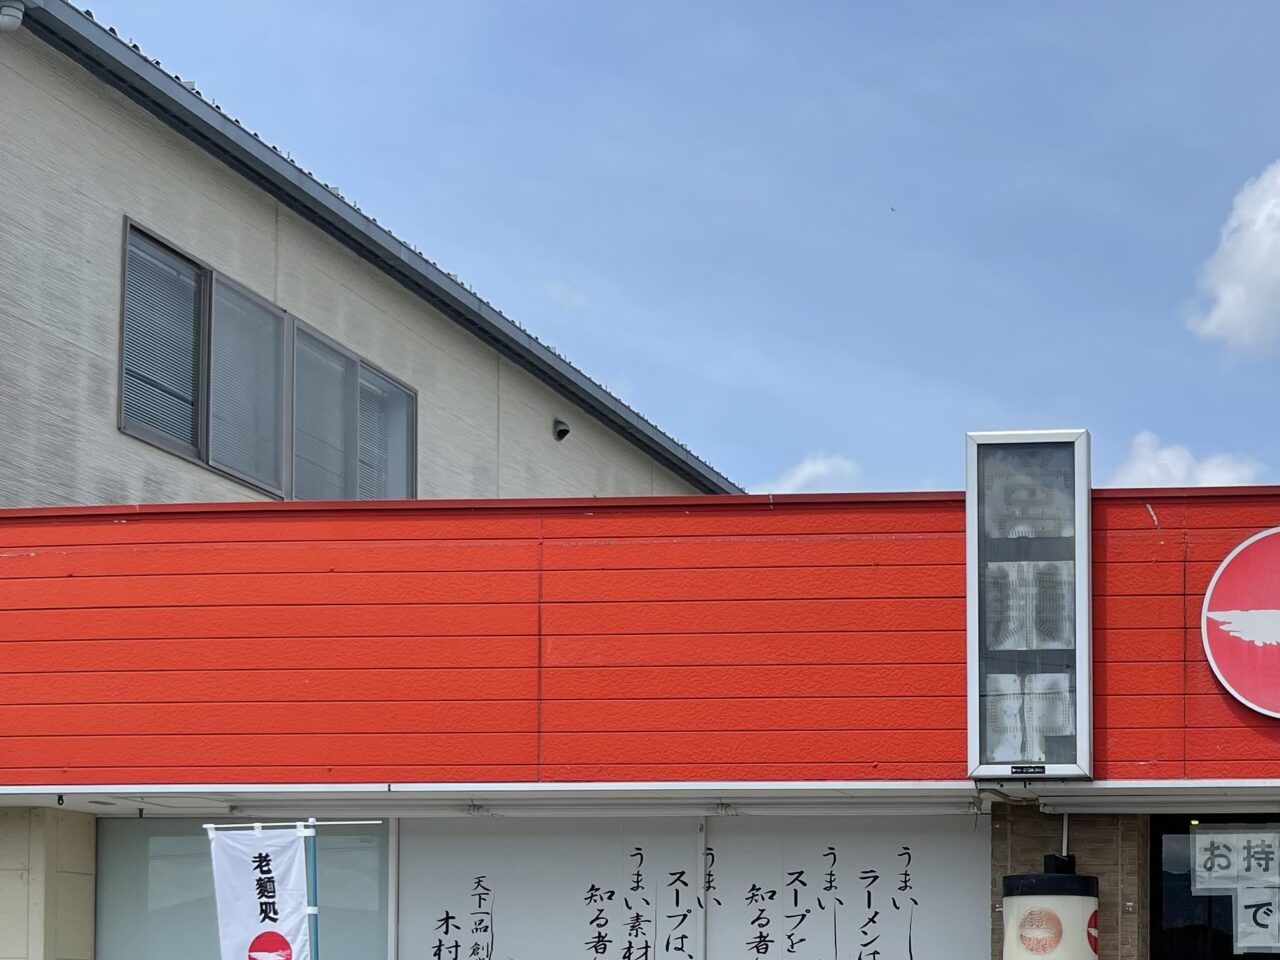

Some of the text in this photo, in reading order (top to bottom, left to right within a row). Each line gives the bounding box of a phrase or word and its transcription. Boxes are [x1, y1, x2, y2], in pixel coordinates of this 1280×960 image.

[470, 875, 491, 933] 天下一品
[697, 848, 722, 909] うまい
[817, 846, 844, 910] うまい
[892, 846, 919, 910] うまい
[784, 870, 811, 953] スープを
